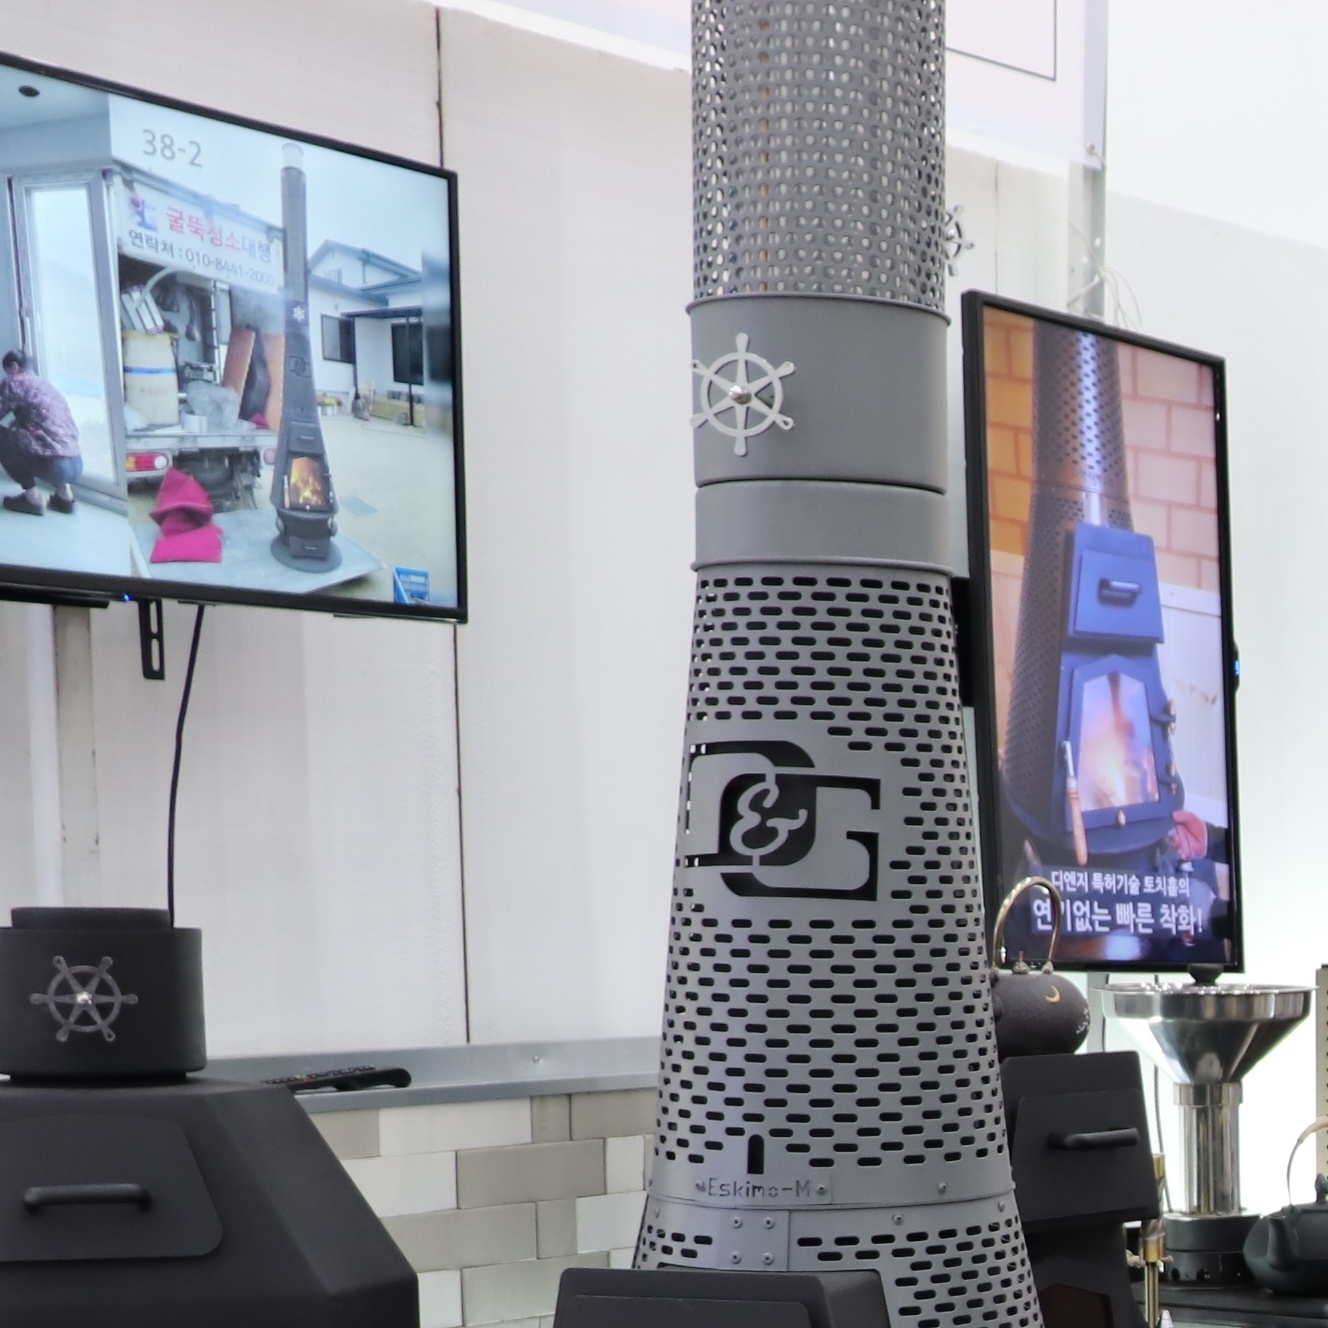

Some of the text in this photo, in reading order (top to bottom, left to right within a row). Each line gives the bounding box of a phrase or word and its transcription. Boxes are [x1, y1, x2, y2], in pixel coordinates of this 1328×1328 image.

[143, 128, 203, 167] 38-2
[1051, 870, 1089, 893] 디엔지
[1091, 872, 1141, 895] 특허기술
[1115, 902, 1155, 934] 빠른
[1159, 903, 1203, 936] 착화!
[708, 1177, 810, 1198] Eskimo-M
